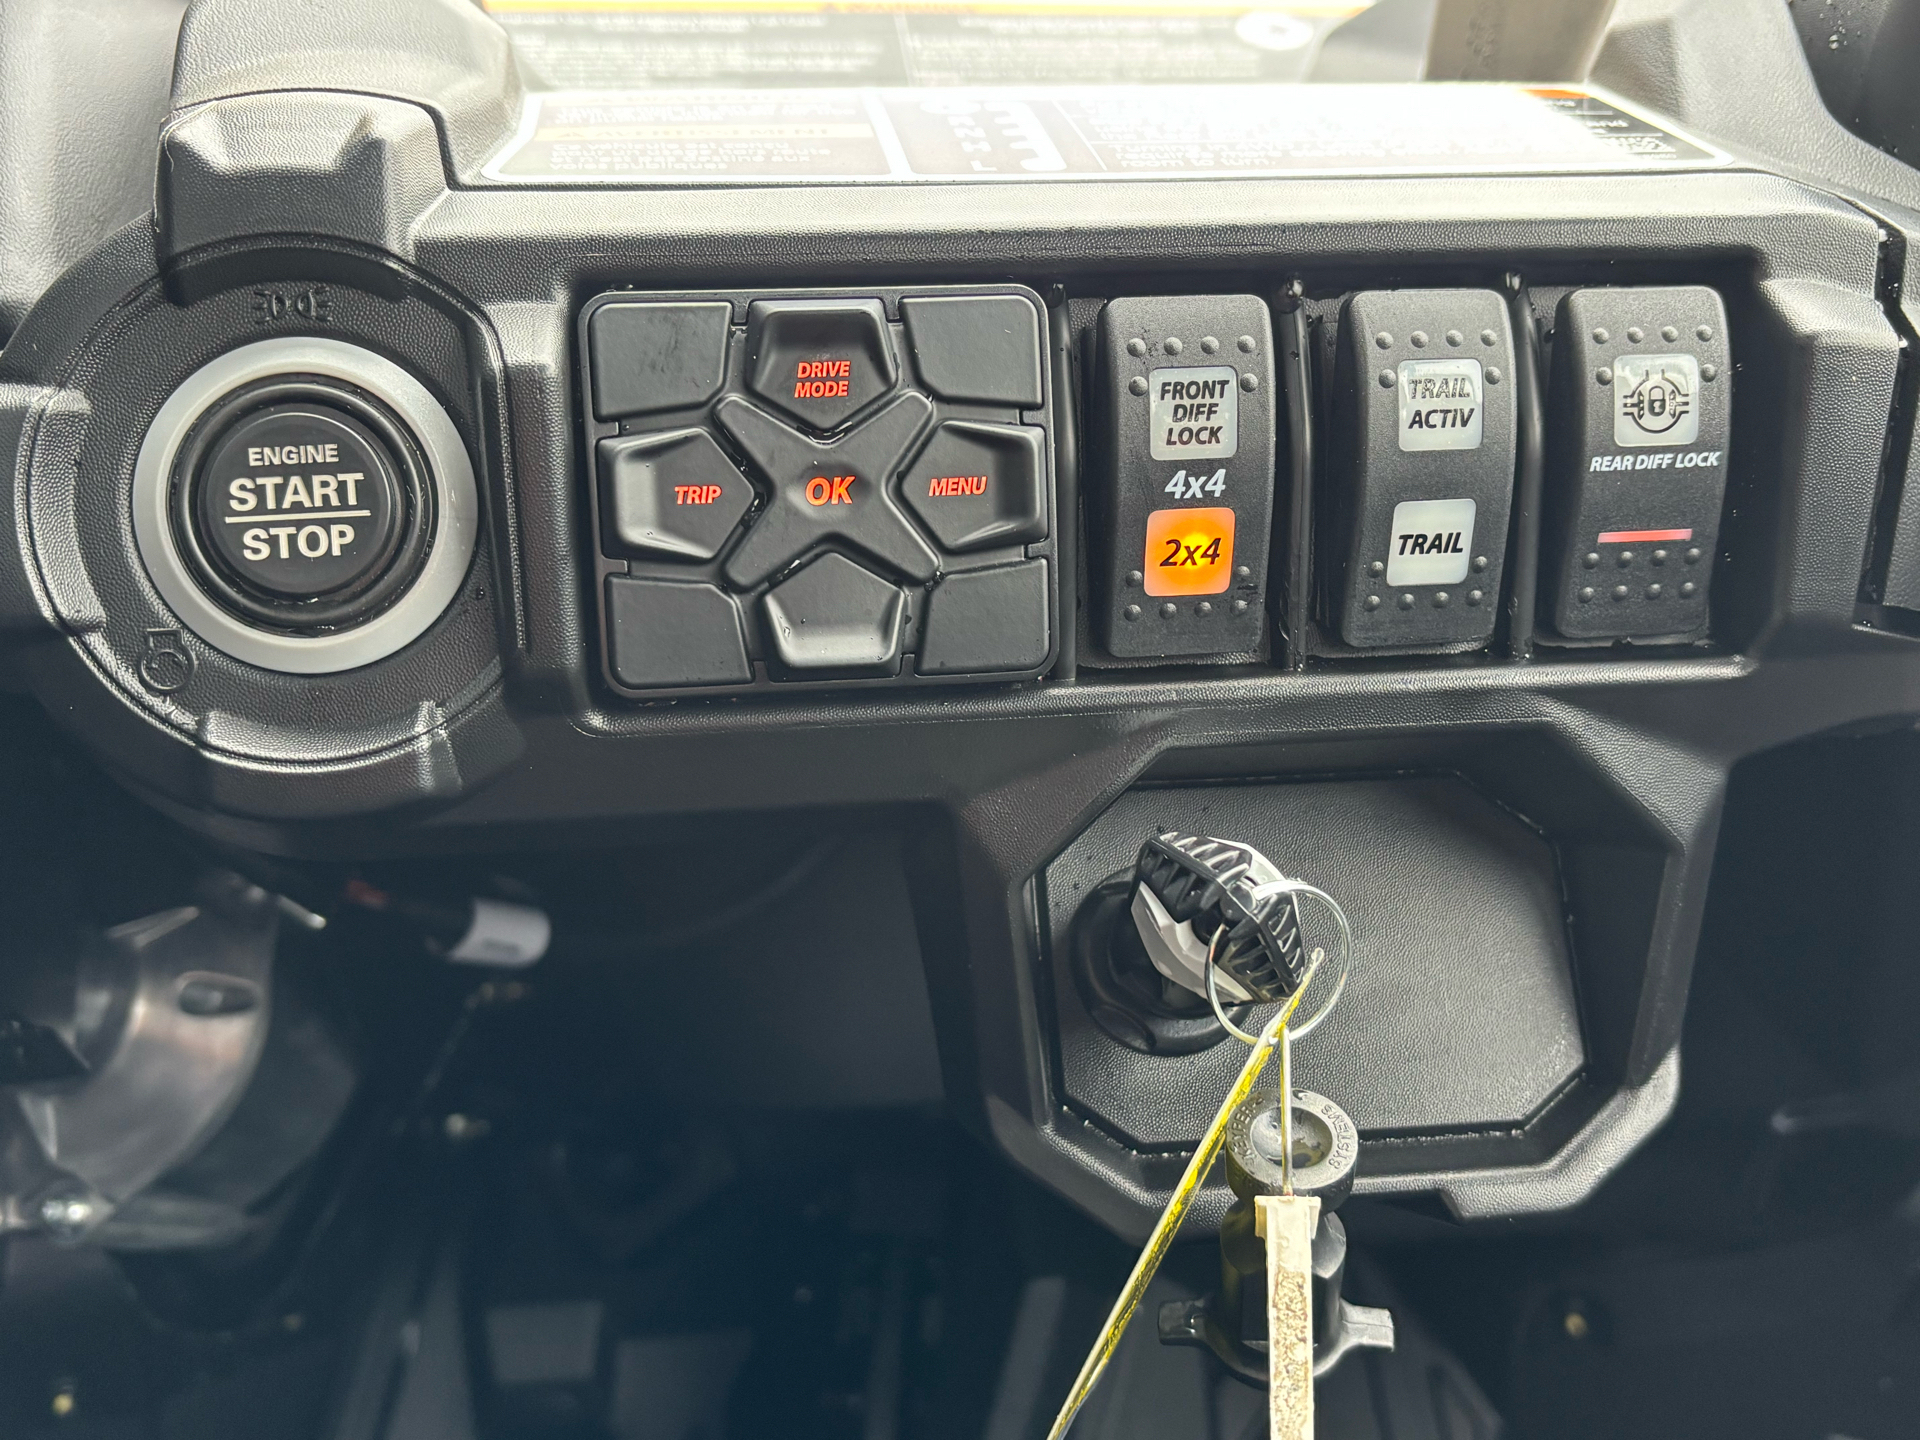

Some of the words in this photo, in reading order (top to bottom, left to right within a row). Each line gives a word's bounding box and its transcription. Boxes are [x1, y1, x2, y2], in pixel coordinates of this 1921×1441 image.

[970, 160, 998, 172] L
[1120, 159, 1185, 168] room
[1189, 158, 1215, 167] to
[797, 361, 851, 379] DRIVE
[794, 381, 849, 398] MODE
[1160, 380, 1230, 401] FRONT
[1409, 377, 1471, 400] TRAIL
[1172, 403, 1219, 423] DIFF
[1408, 408, 1475, 430] ACTIV
[1166, 426, 1224, 446] LOCK
[248, 443, 340, 467] ENGINE
[1589, 455, 1634, 472] REAR
[1635, 454, 1673, 470] DIFF
[1674, 452, 1722, 468] LOCK
[229, 472, 365, 512] START
[805, 476, 856, 506] OK
[929, 476, 988, 497] MENU
[1165, 469, 1227, 499] 4x4
[674, 485, 722, 505] TRIP
[242, 524, 356, 562] STOP
[1160, 538, 1222, 567] 2x4
[1398, 532, 1464, 556] TRAIL
